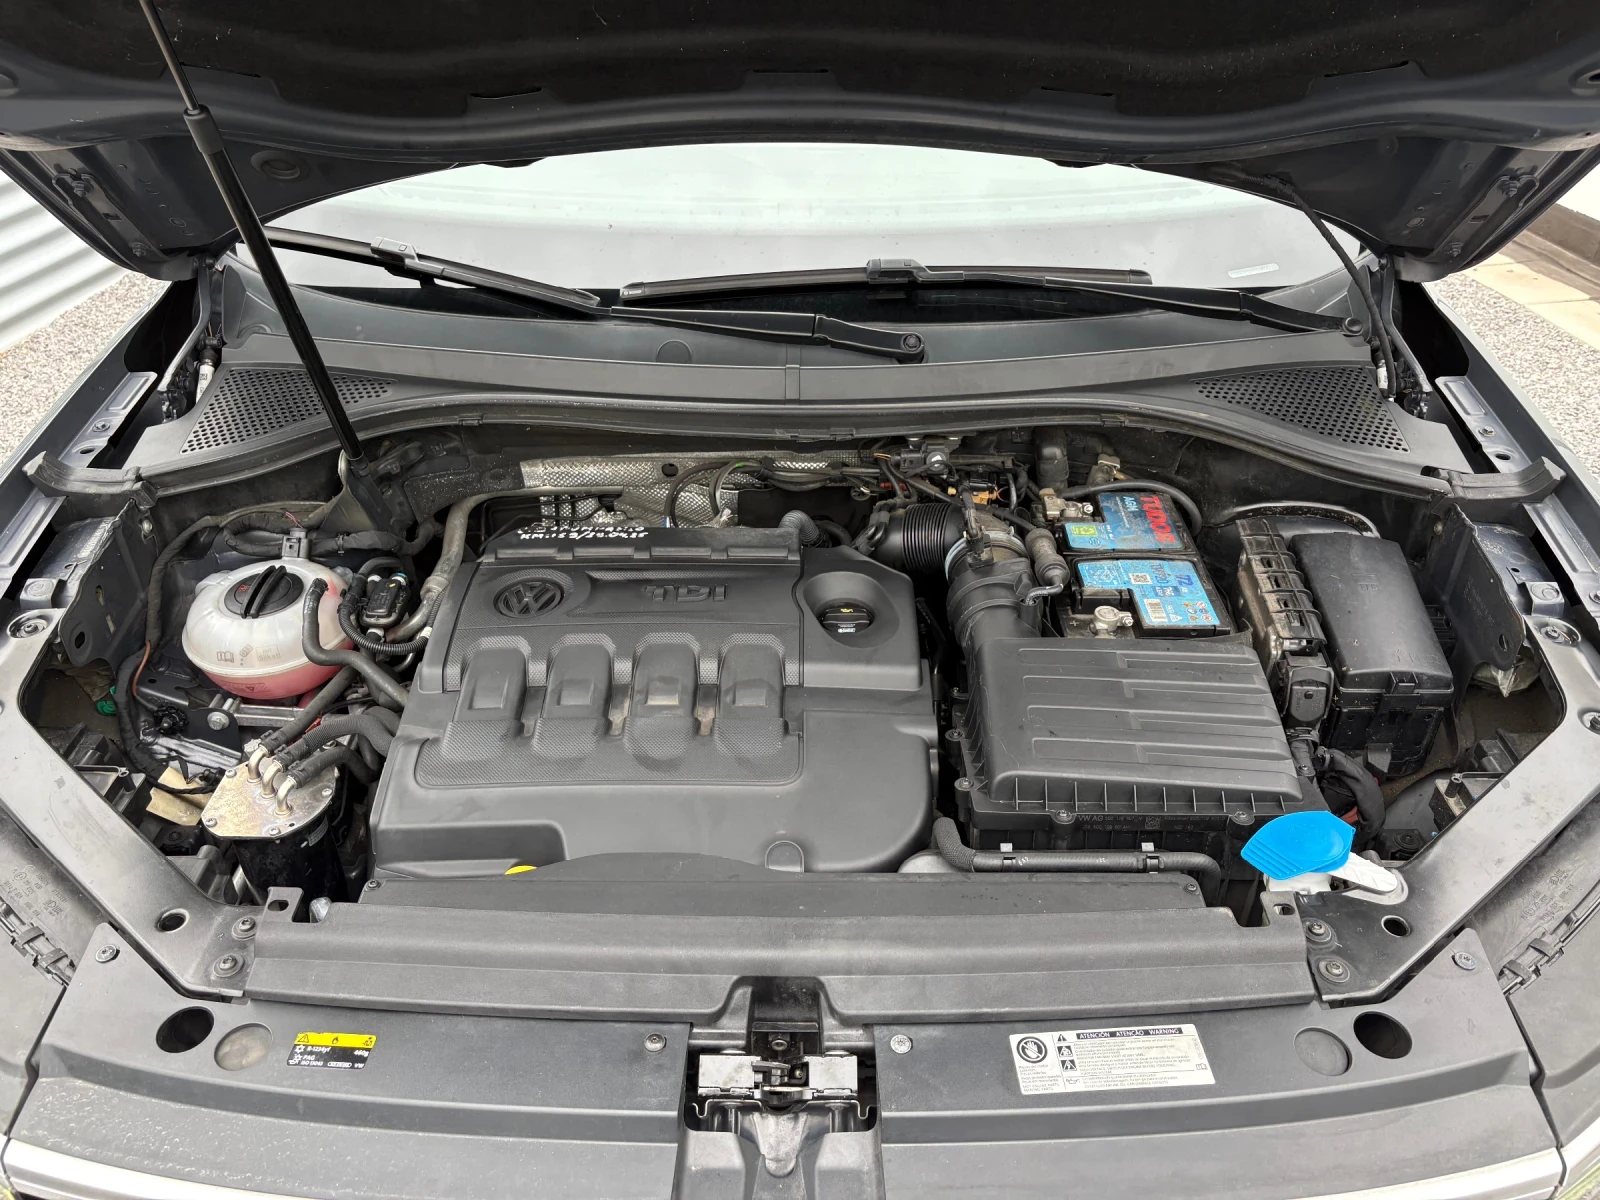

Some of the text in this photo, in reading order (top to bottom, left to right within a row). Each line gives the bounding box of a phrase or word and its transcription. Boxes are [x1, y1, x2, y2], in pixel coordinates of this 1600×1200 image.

[1123, 496, 1138, 511] AGM
[1141, 496, 1175, 543] TUDOR
[1174, 574, 1194, 586] 72
[644, 584, 727, 602] TDI
[1080, 1027, 1180, 1039] ATENCIÓN ATENÇÃO WARNING
[353, 1049, 369, 1057] 460g
